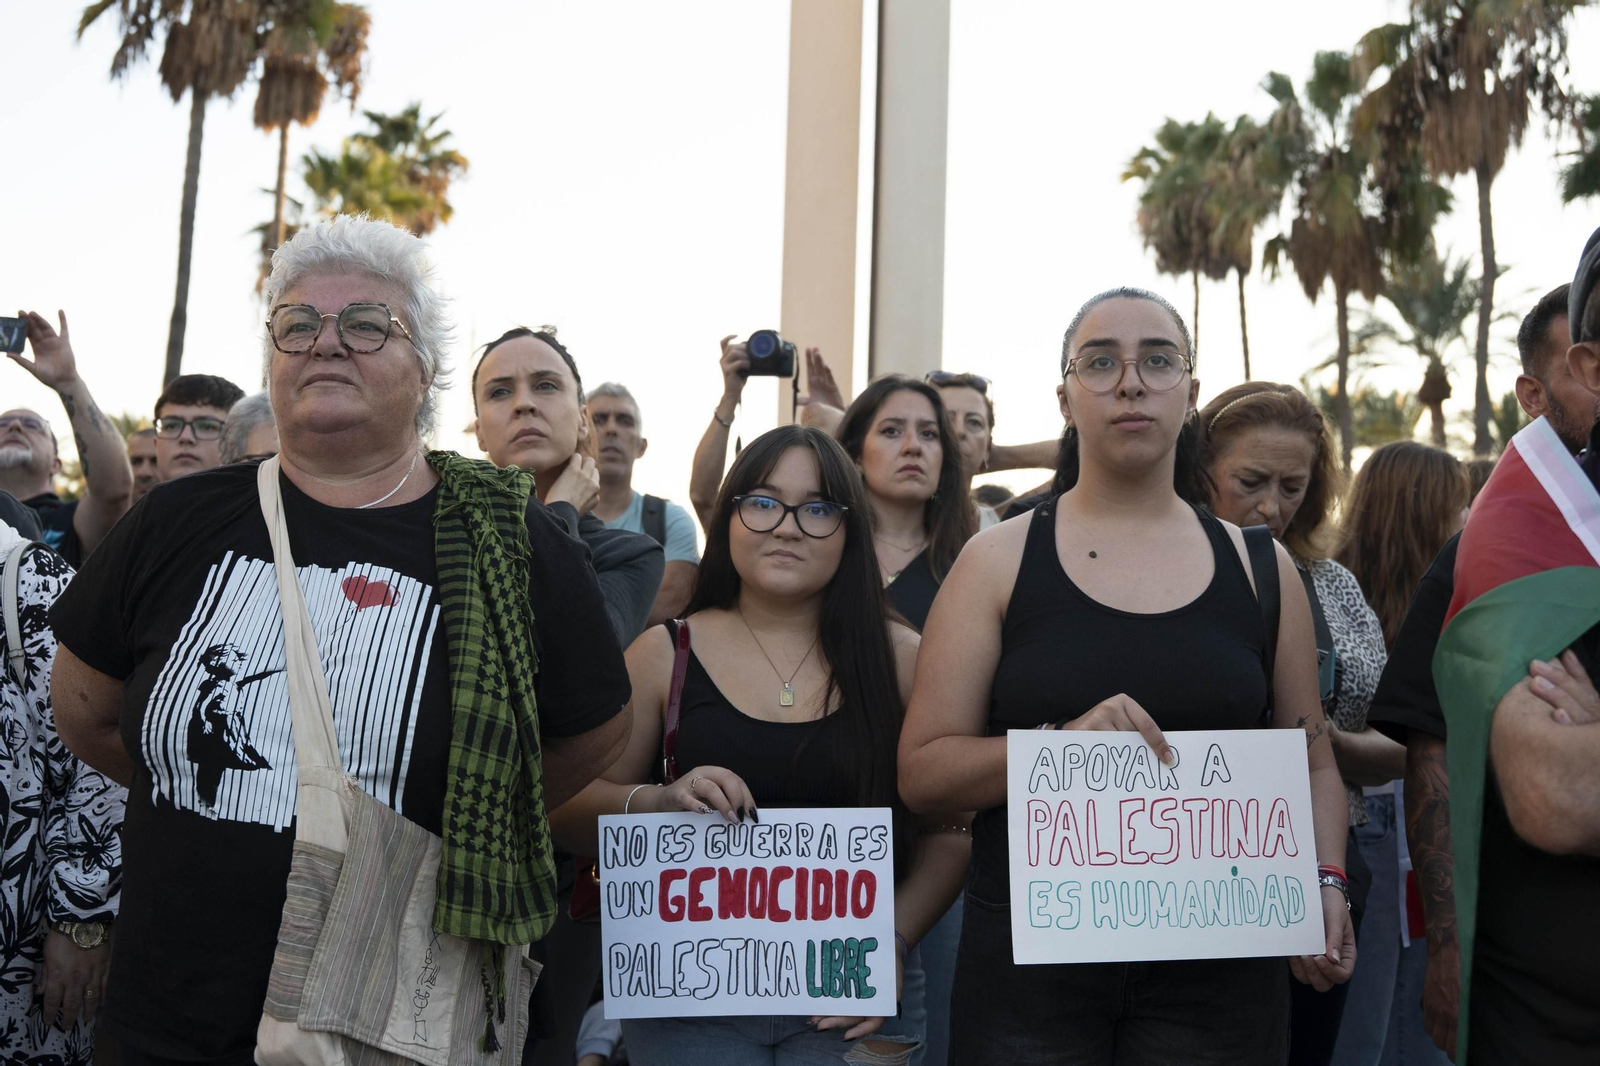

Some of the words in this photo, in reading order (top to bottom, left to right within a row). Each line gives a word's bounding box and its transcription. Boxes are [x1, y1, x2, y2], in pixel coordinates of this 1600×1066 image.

[1028, 743, 1180, 792] APOYAR
[1201, 743, 1232, 786] A
[604, 825, 648, 869] NO
[656, 824, 696, 863] ES
[704, 822, 838, 859] GUERRA
[847, 825, 888, 862] ES
[1027, 797, 1299, 867] PALESTINA
[606, 880, 654, 919] UN
[658, 866, 877, 922] GENOCIDIO
[1028, 880, 1082, 930] ES
[608, 937, 800, 1000] PALESTINA
[806, 937, 878, 999] LIBRE
